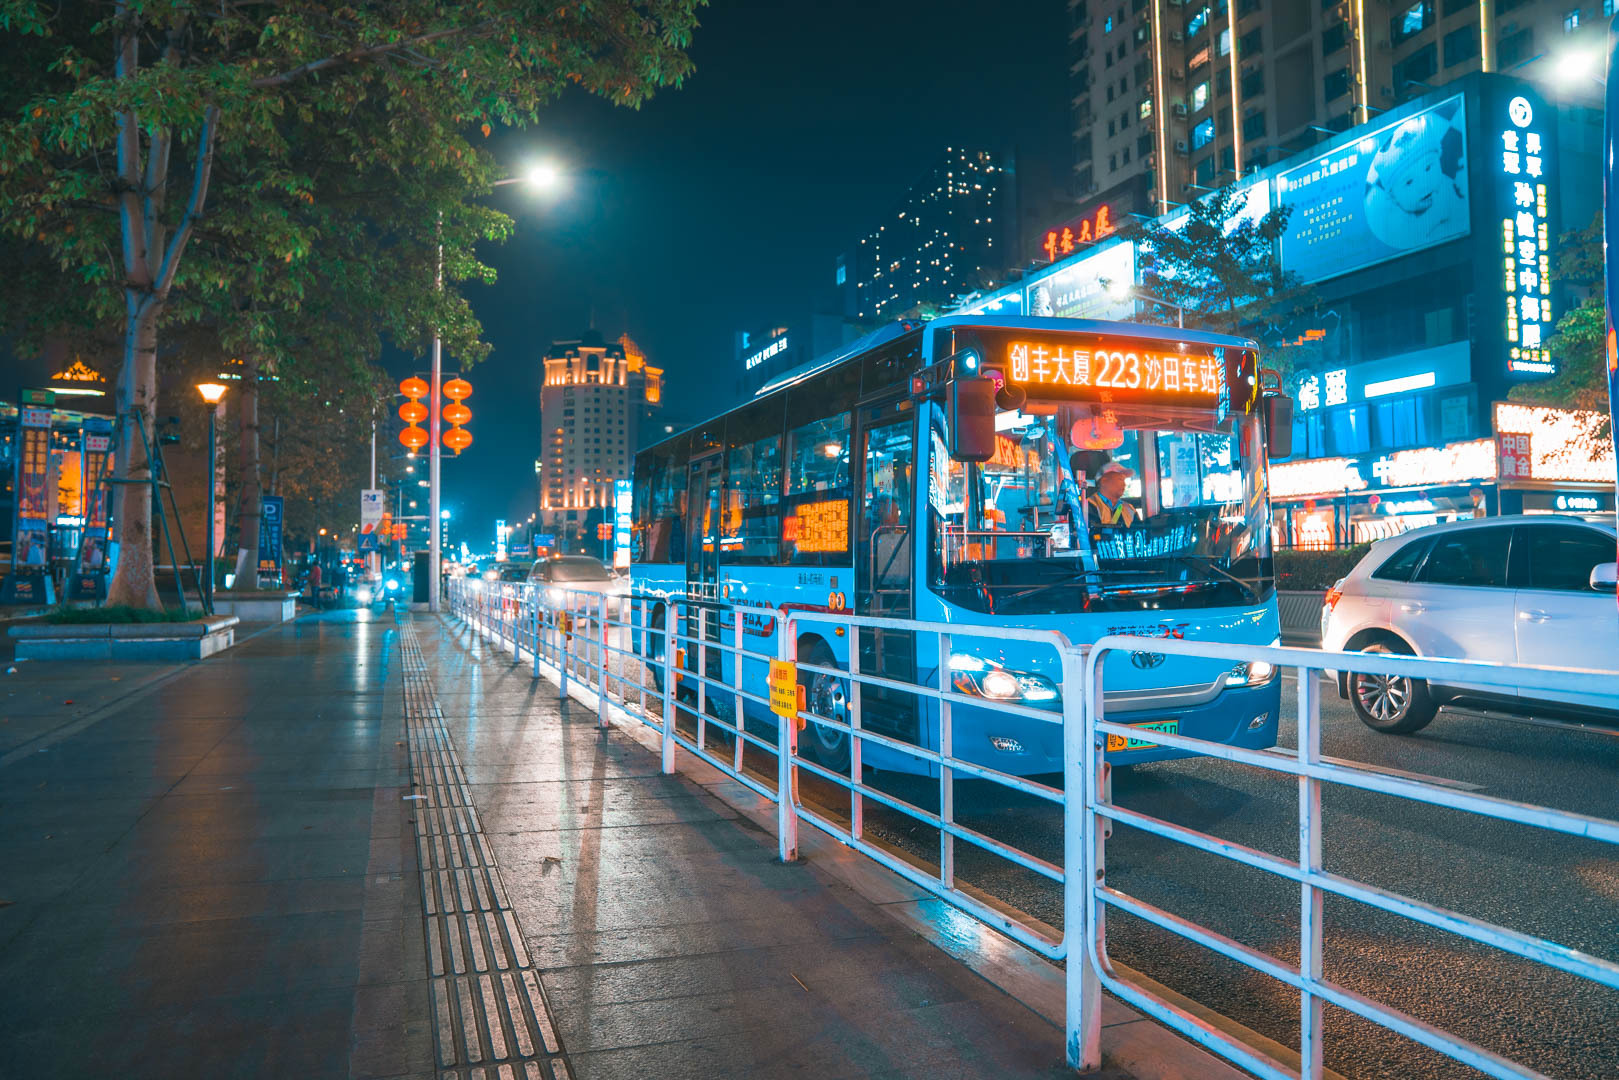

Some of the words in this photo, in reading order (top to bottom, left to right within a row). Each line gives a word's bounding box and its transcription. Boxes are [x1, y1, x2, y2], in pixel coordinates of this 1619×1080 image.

[1010, 344, 1091, 386] 创丰大厦
[1094, 351, 1140, 389] 223
[1144, 353, 1218, 394] 沙田车站
[1502, 434, 1530, 455] 中国
[1502, 455, 1532, 477] 黄金
